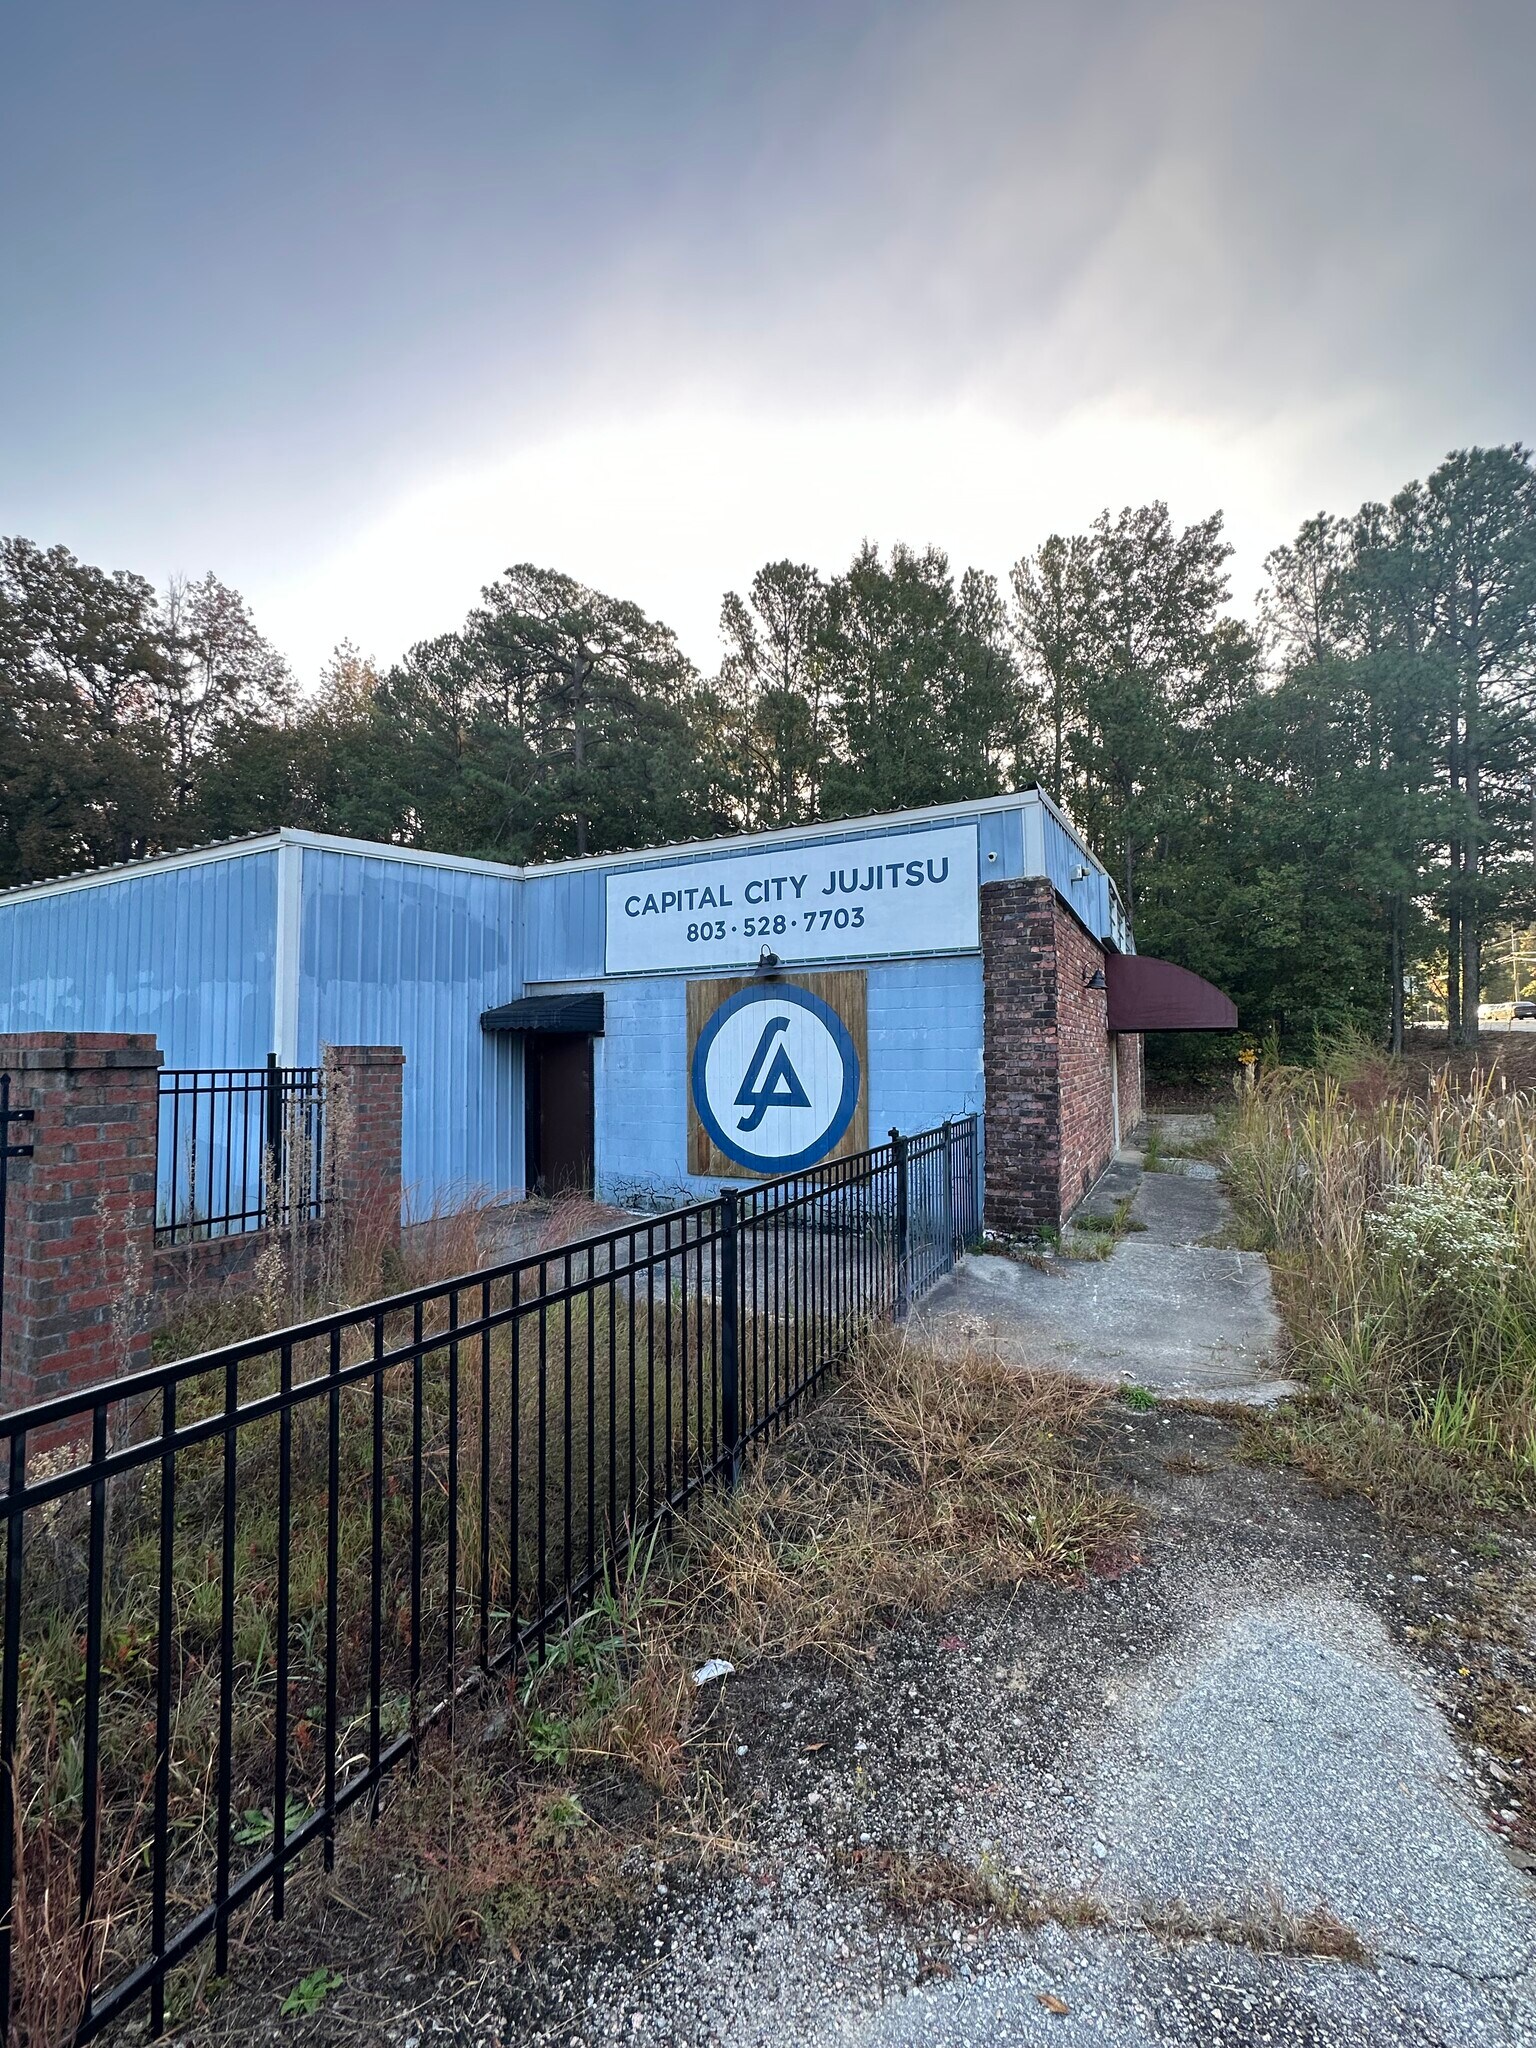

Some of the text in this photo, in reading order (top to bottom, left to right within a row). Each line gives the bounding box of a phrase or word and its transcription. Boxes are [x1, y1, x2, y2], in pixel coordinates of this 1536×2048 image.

[624, 857, 949, 917] CAPITAL CITY JUJITSU
